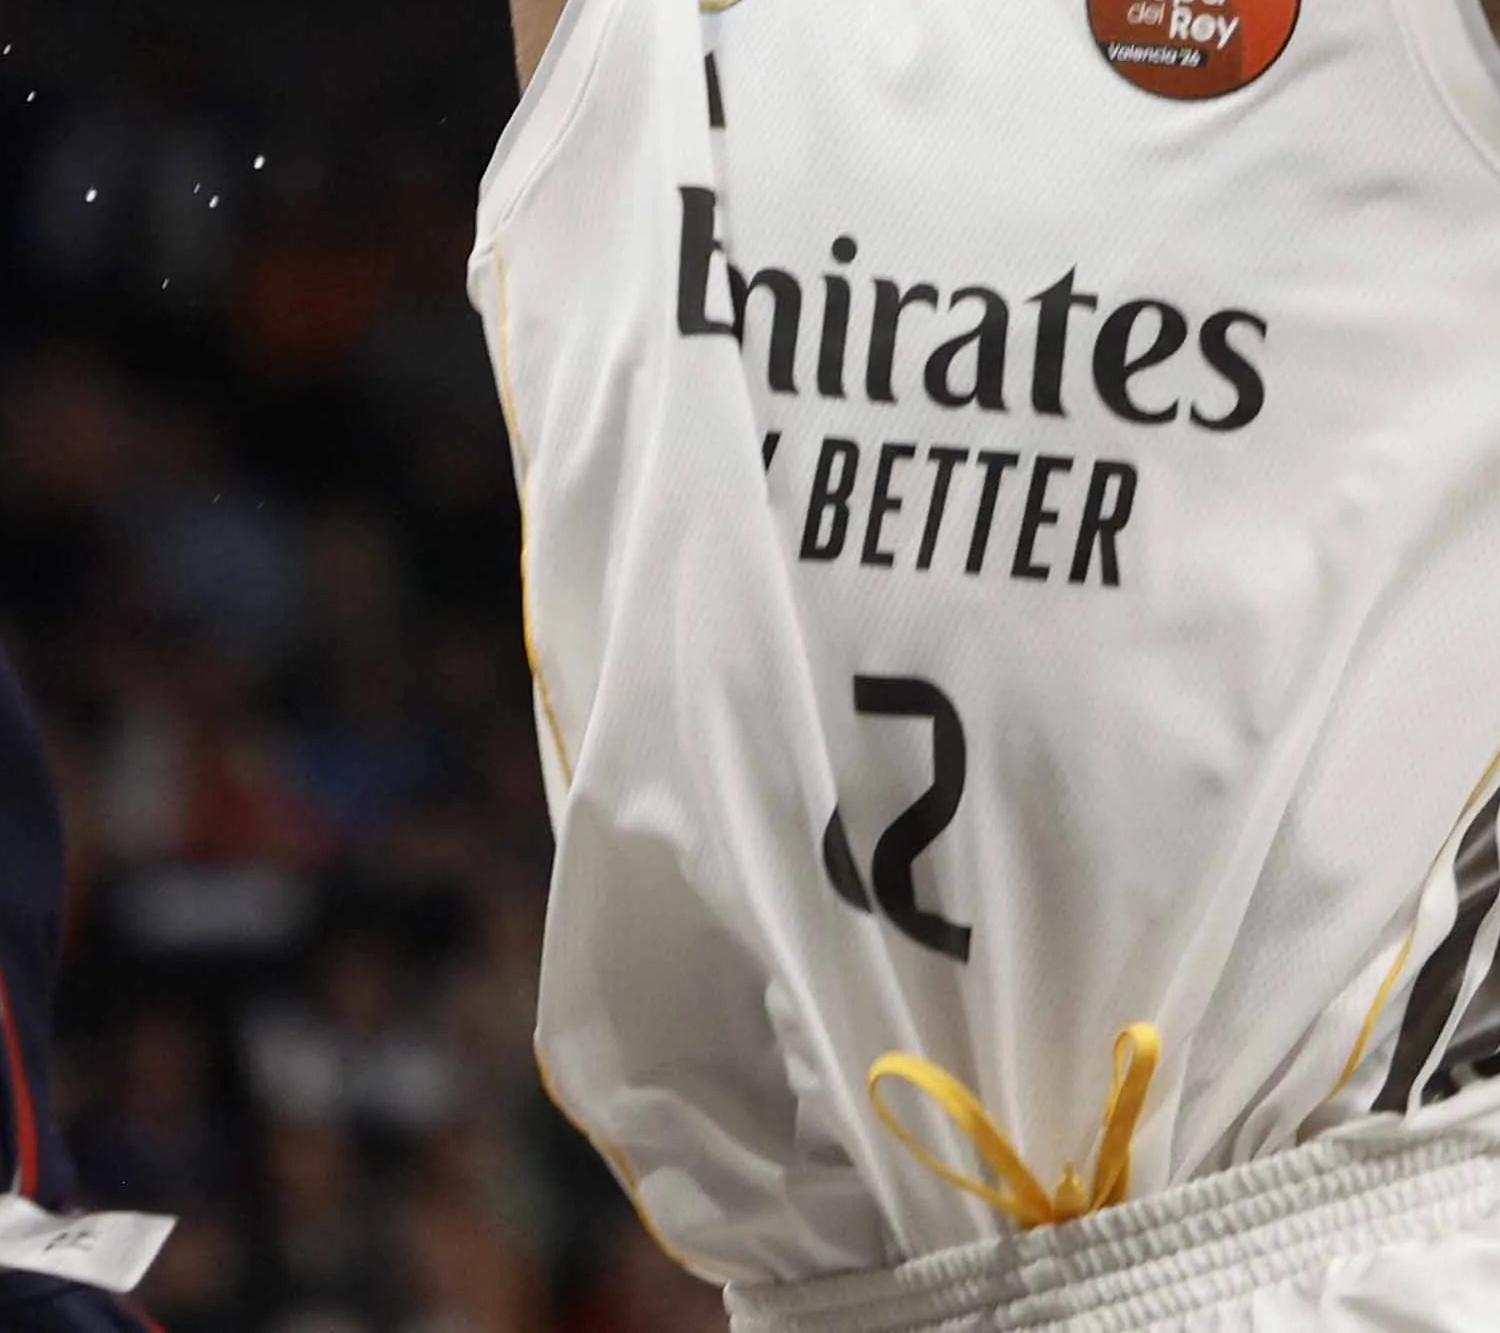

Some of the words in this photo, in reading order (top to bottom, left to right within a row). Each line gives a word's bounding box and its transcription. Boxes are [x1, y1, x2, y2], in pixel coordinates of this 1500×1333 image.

[1127, 0, 1166, 26] del
[1168, 5, 1241, 51] Rey
[1106, 41, 1178, 66] Valencia
[798, 437, 1140, 588] BETTER
